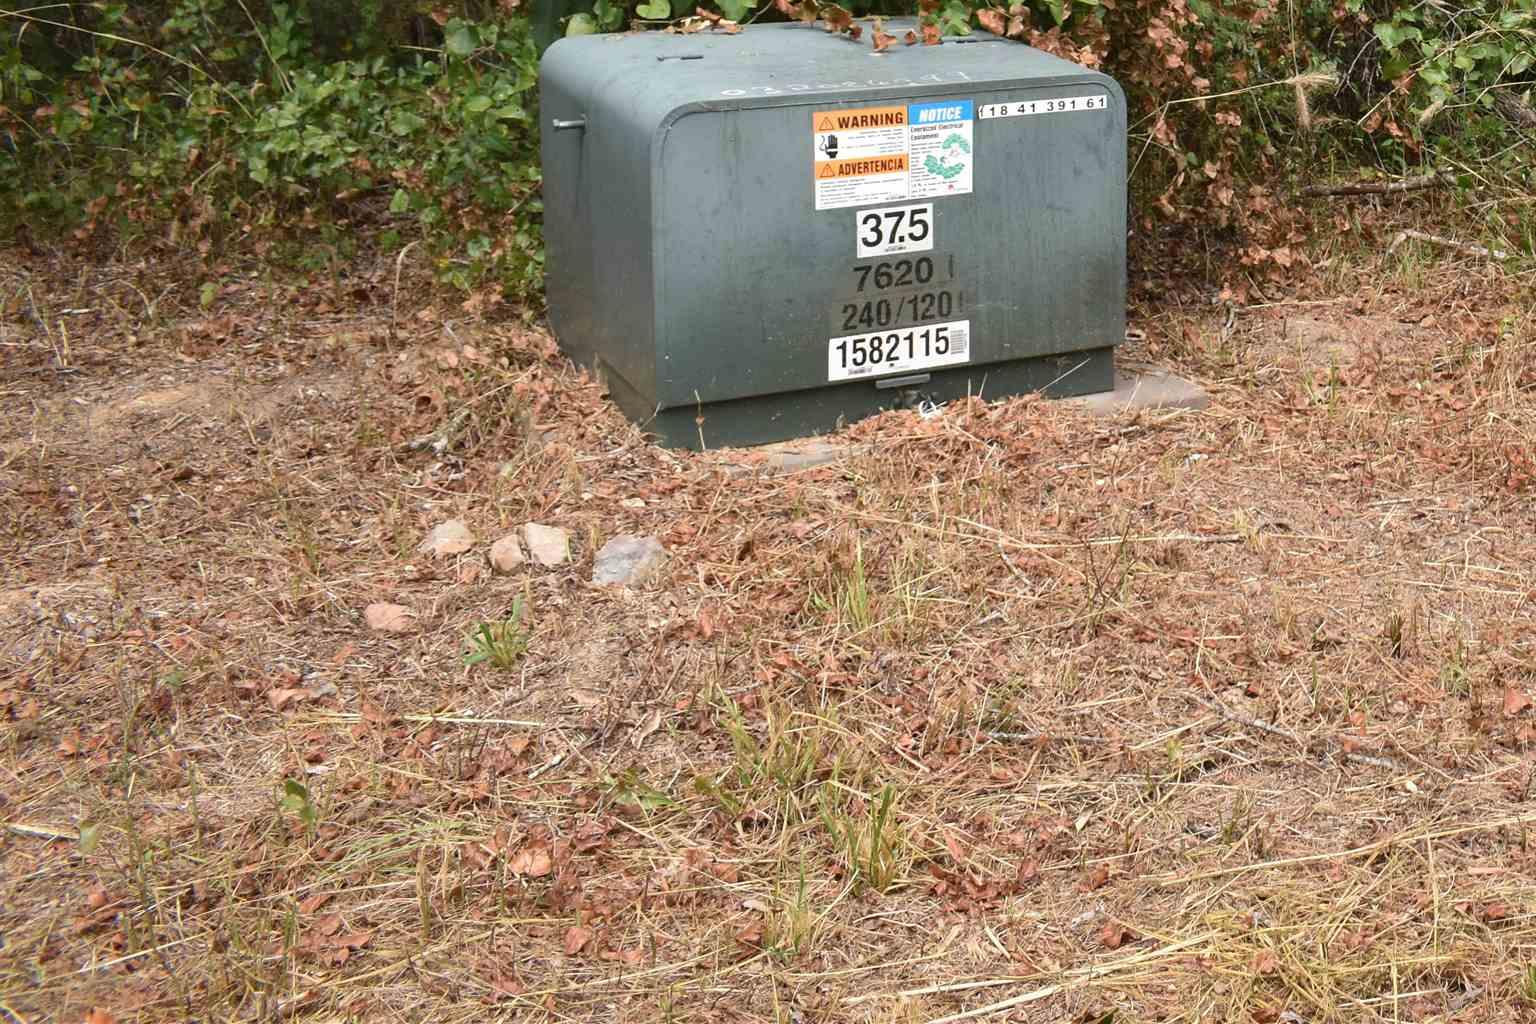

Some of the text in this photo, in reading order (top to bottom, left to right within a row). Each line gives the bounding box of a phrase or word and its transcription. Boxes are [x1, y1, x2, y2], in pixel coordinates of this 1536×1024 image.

[837, 112, 904, 129] WARNING
[919, 106, 963, 122] NOTICE
[838, 158, 904, 177] ADVERTENCIA
[861, 208, 929, 248] 37.5
[853, 257, 934, 292] 7620
[841, 291, 952, 331] 240/120
[836, 327, 949, 368] 1582115
